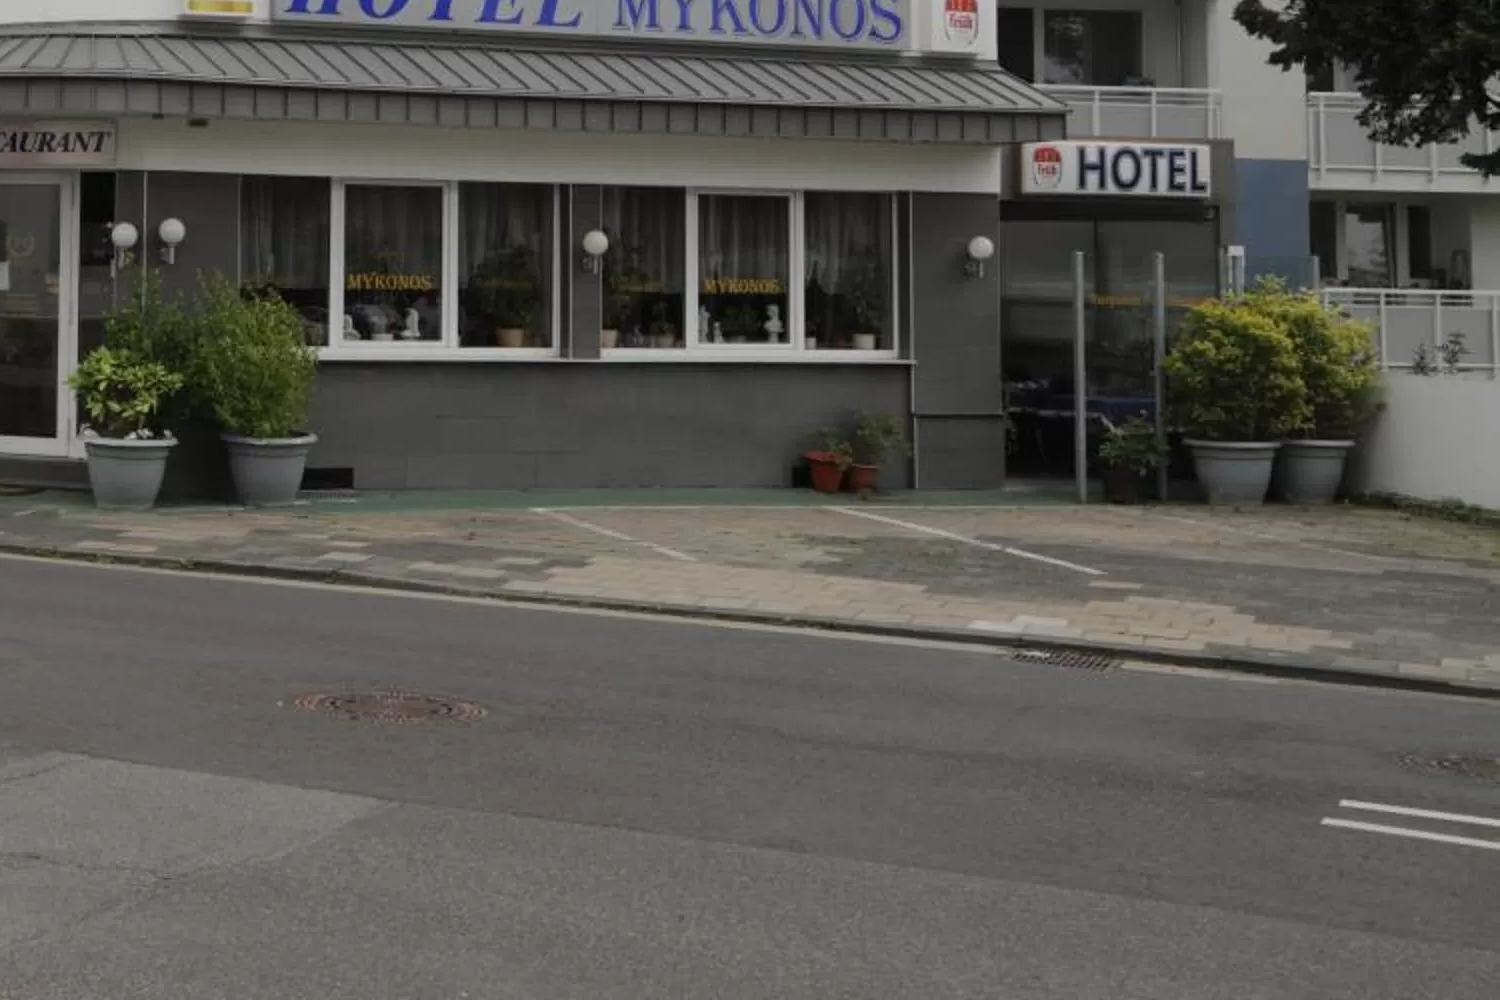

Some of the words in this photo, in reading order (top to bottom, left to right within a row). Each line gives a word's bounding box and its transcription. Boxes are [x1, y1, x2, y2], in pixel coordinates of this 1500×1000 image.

[1077, 145, 1208, 193] HOTEL
[347, 272, 433, 291] MYKONOS
[704, 278, 781, 294] MYKONOS
